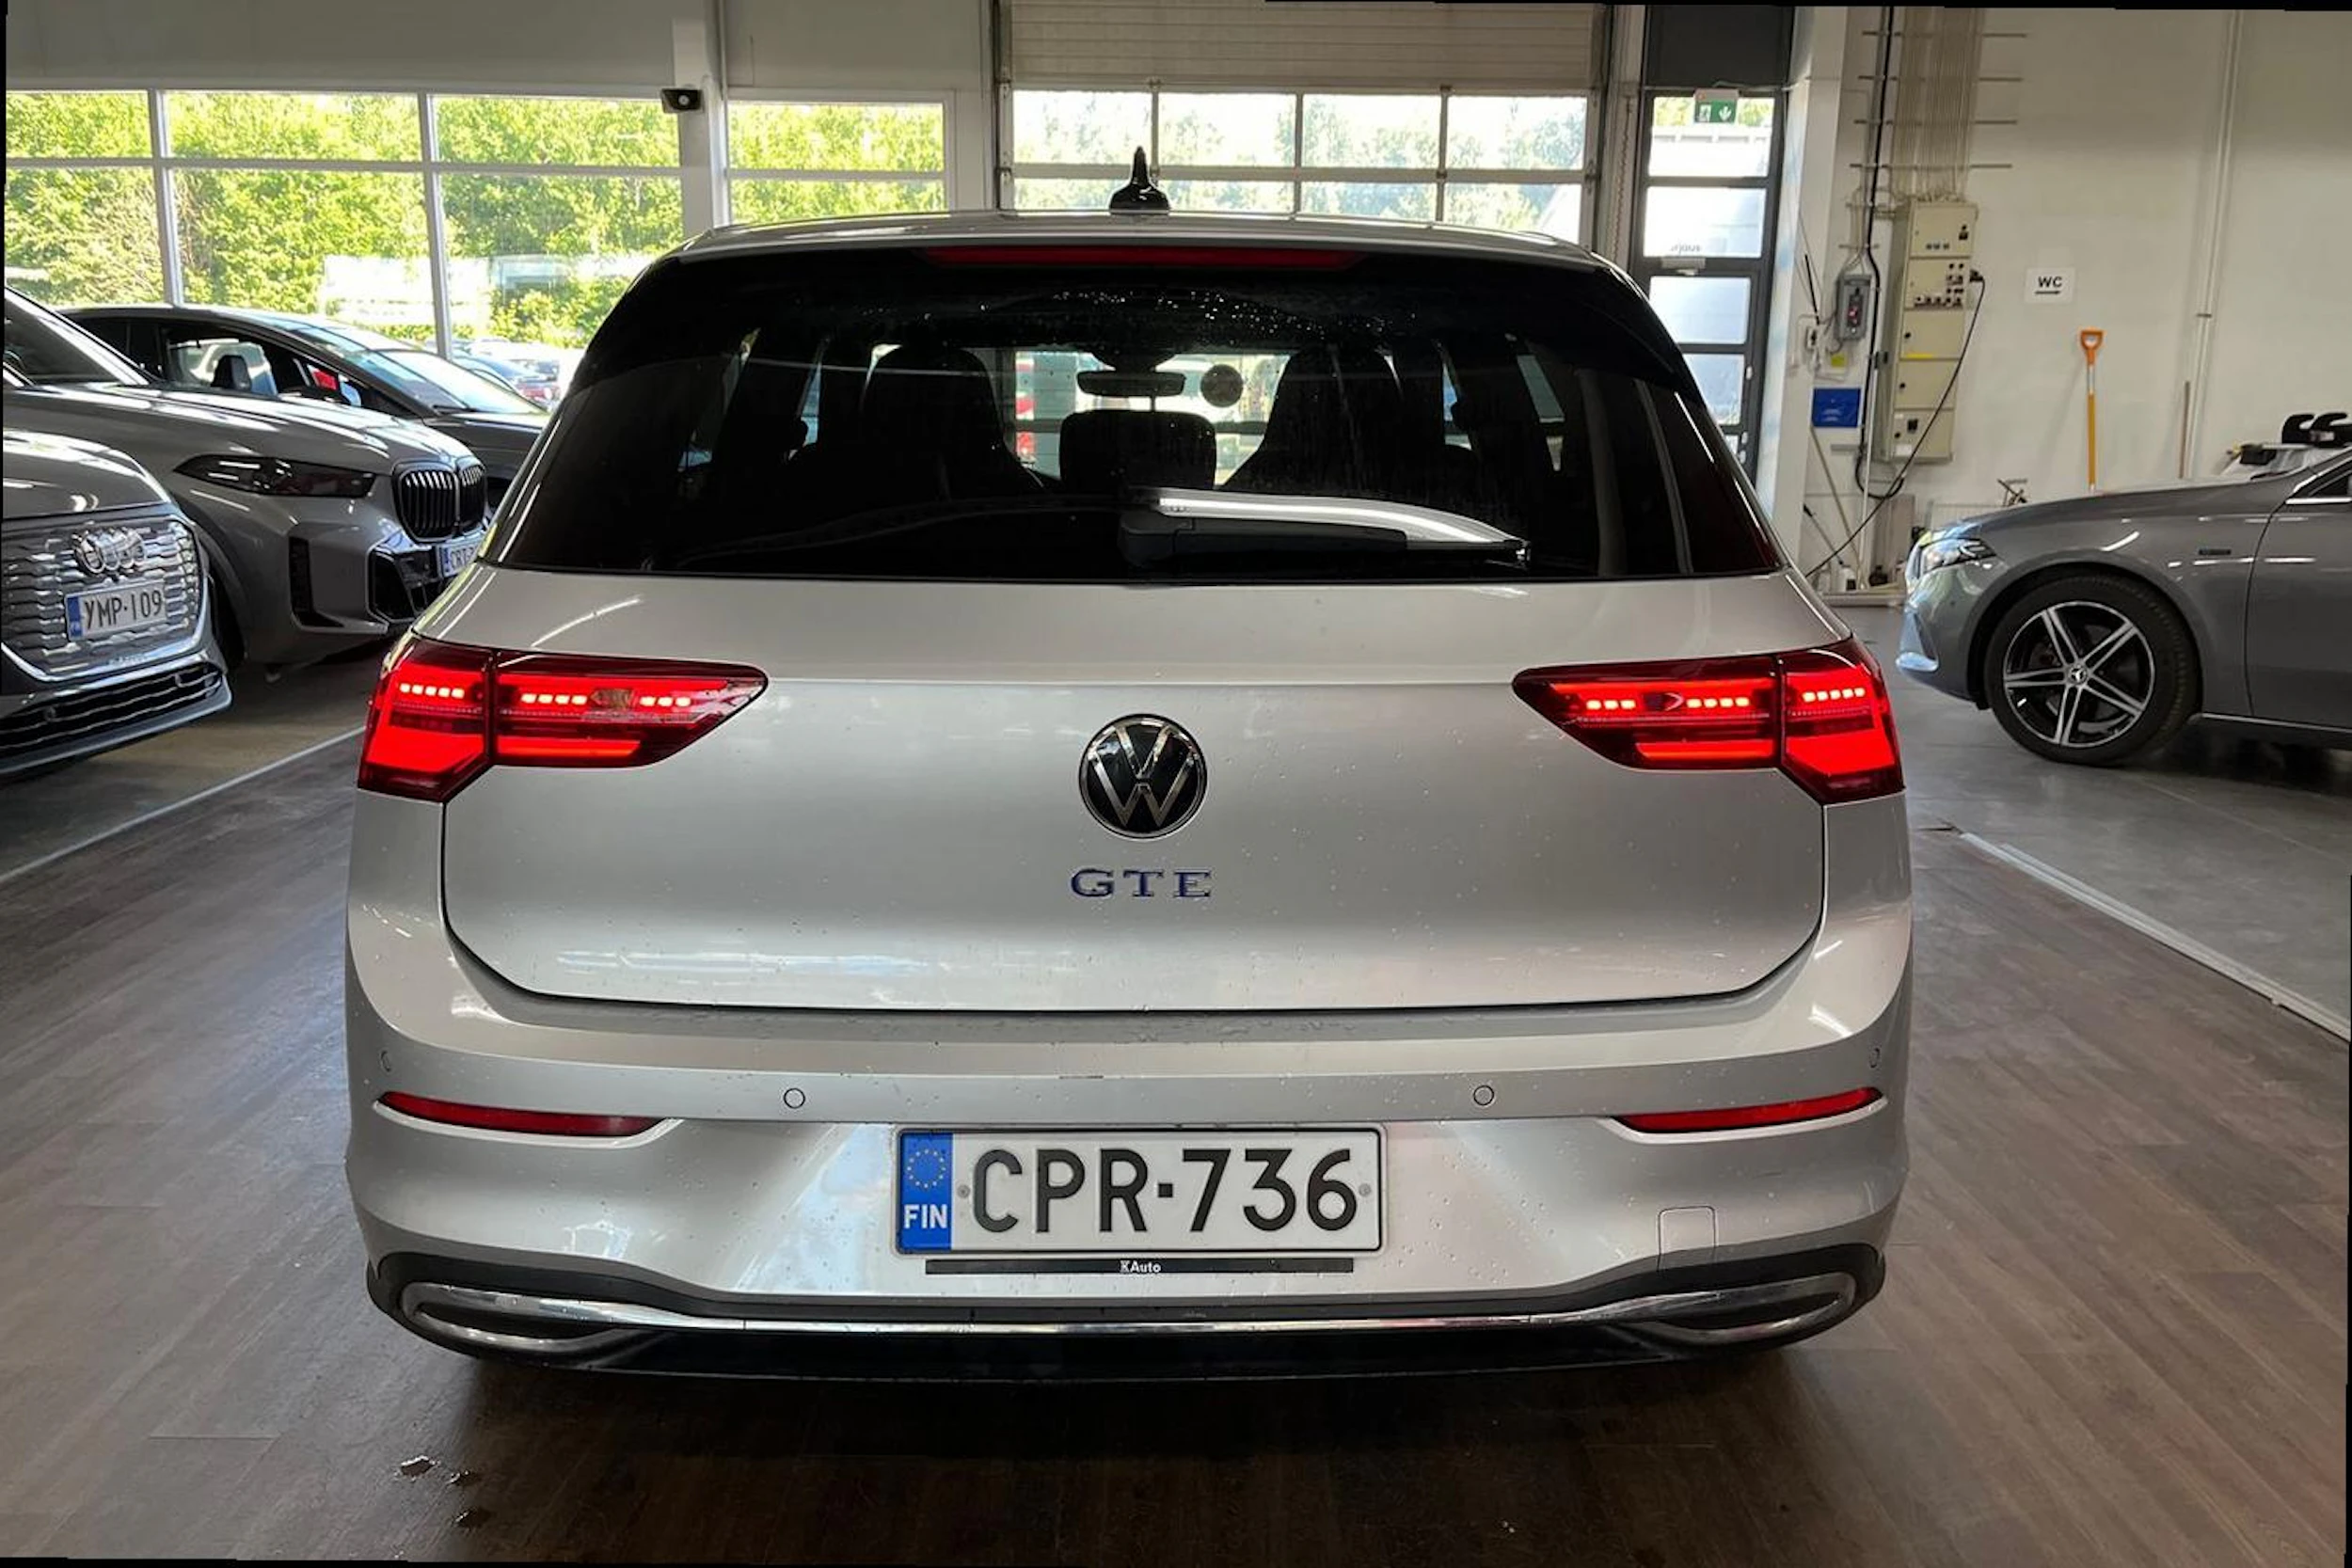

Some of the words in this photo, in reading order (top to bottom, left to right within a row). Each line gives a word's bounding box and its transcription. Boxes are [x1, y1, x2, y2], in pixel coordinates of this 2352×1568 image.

[2038, 276, 2063, 288] WC
[84, 590, 161, 630] YMP-109
[1070, 867, 1213, 898] GTE
[972, 1148, 1358, 1233] CPR-736
[903, 1204, 948, 1229] FIN
